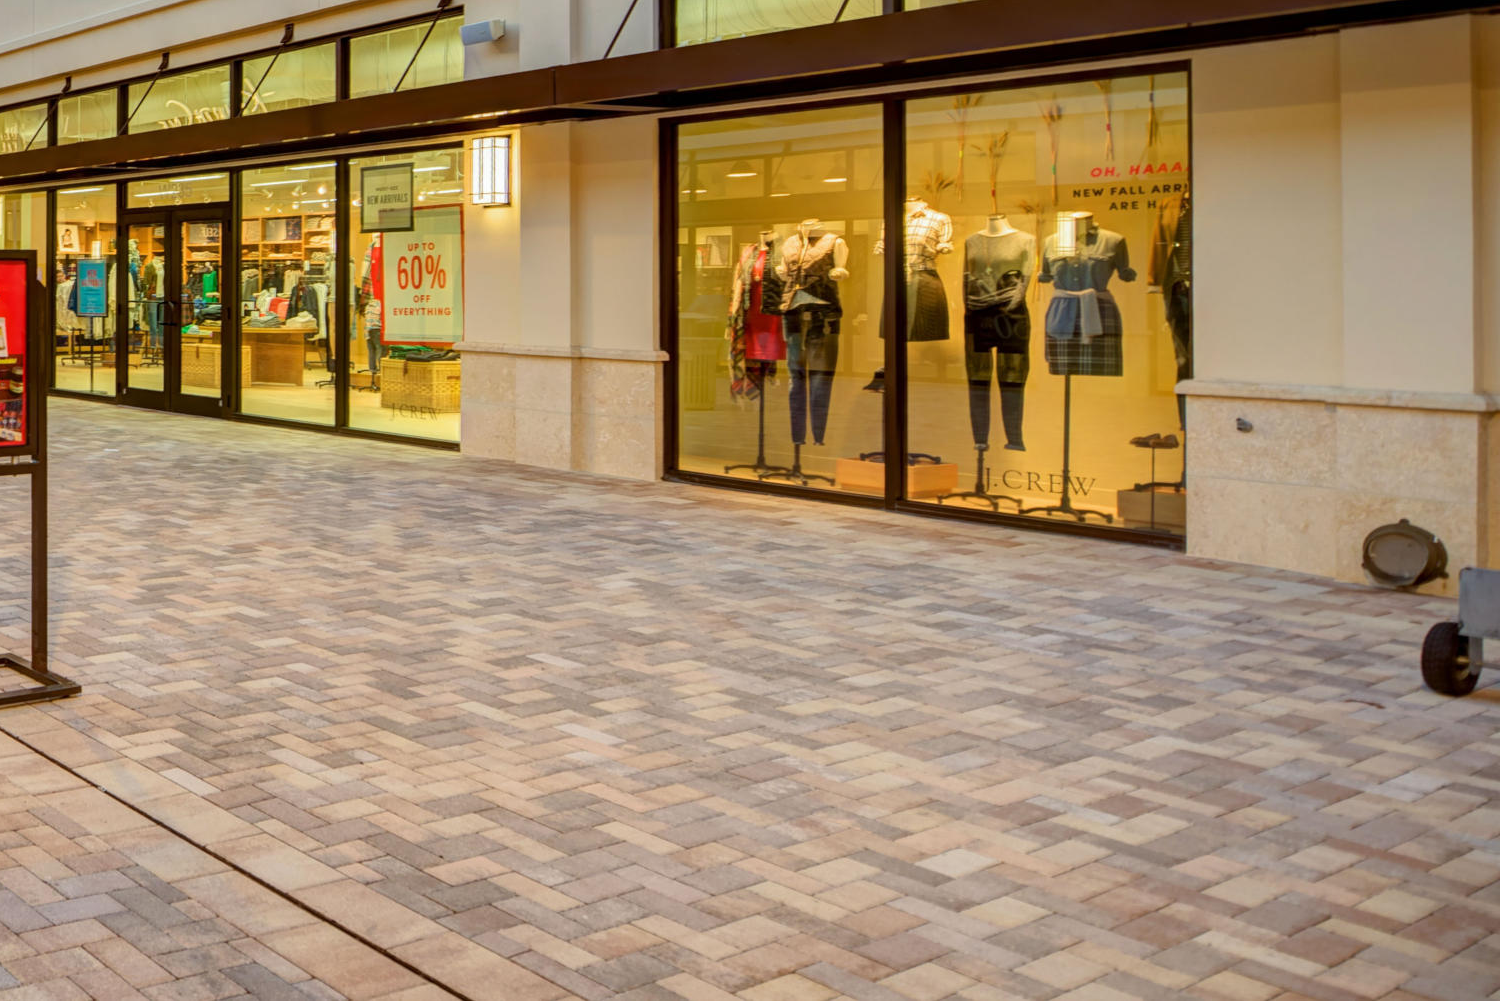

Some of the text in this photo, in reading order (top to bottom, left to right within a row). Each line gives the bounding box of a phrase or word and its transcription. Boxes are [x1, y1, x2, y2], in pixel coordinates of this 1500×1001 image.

[1090, 161, 1189, 178] OH, HAAA
[1073, 188, 1105, 198] NEW
[1110, 186, 1146, 196] FALL
[1109, 200, 1140, 211] ARE
[407, 242, 435, 252] UP TO
[397, 254, 447, 290] 60%
[412, 294, 431, 304] OFF
[392, 307, 452, 316] EVERYTHING
[984, 467, 1096, 496] J.CREW
